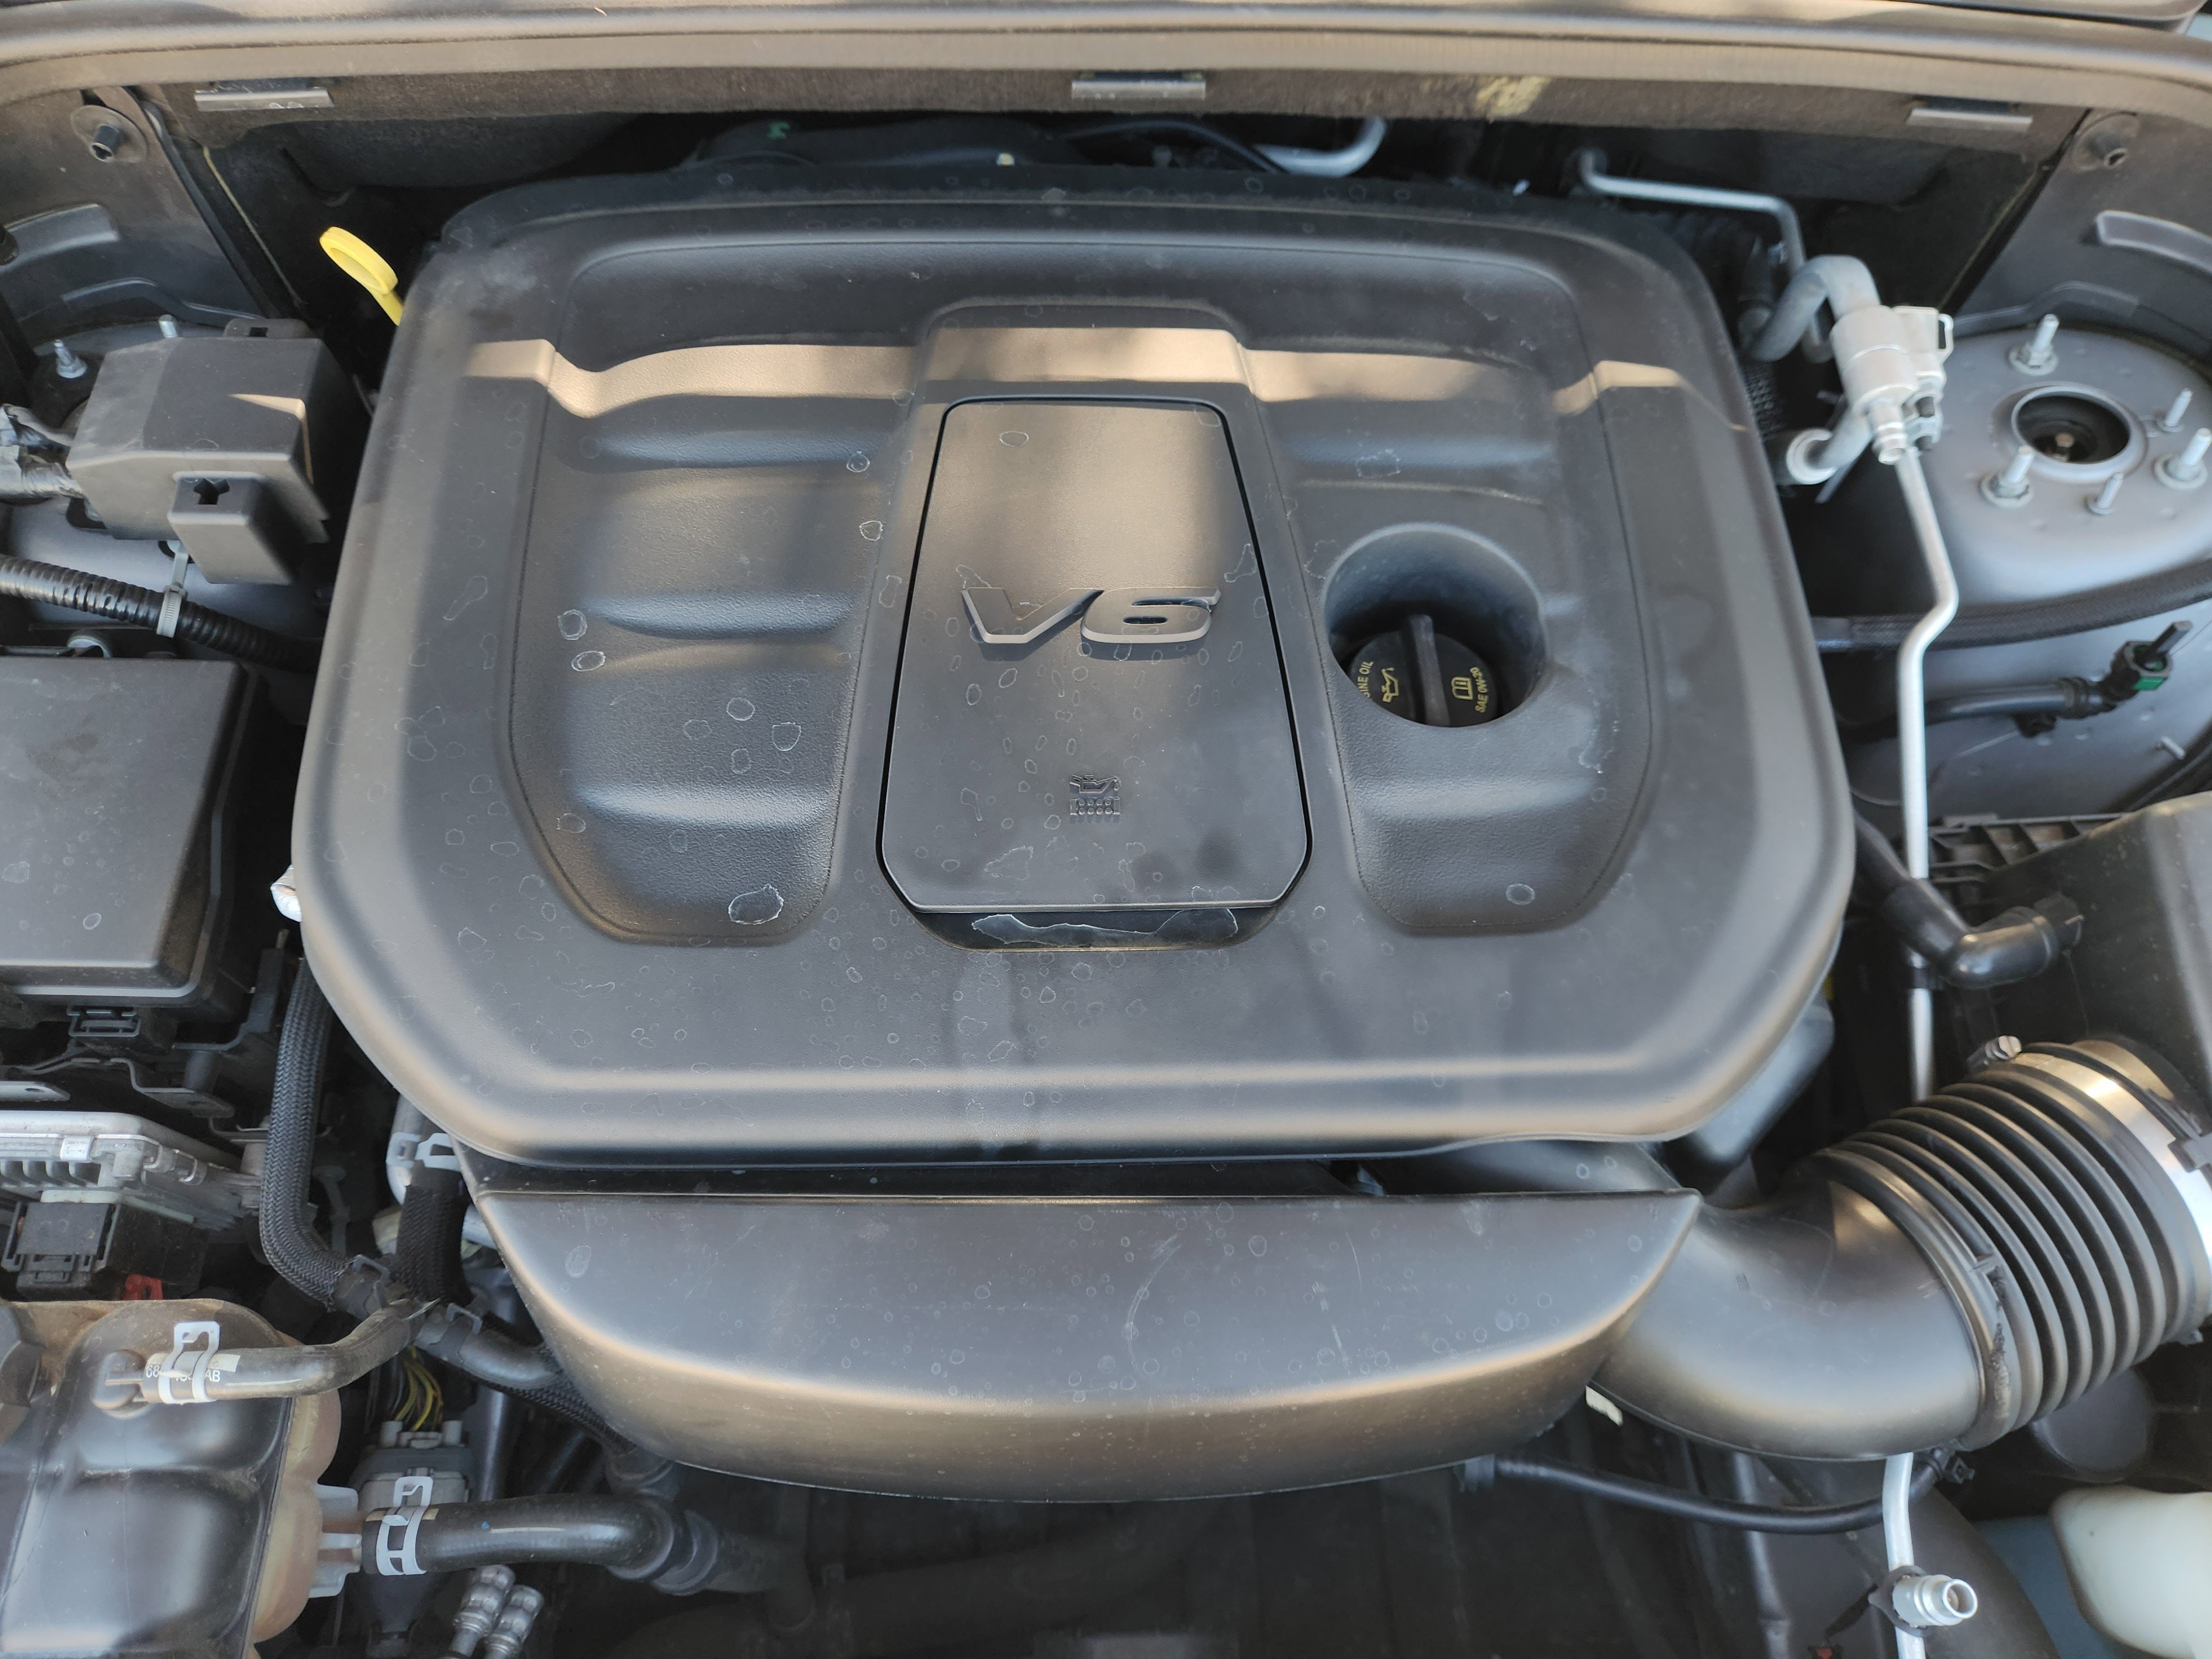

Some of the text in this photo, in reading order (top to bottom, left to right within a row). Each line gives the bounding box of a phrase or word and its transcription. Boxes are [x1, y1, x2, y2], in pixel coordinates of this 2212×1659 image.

[961, 587, 1221, 644] V6
[1359, 661, 1374, 675] OIL
[1470, 666, 1488, 713] SAE 0W-20
